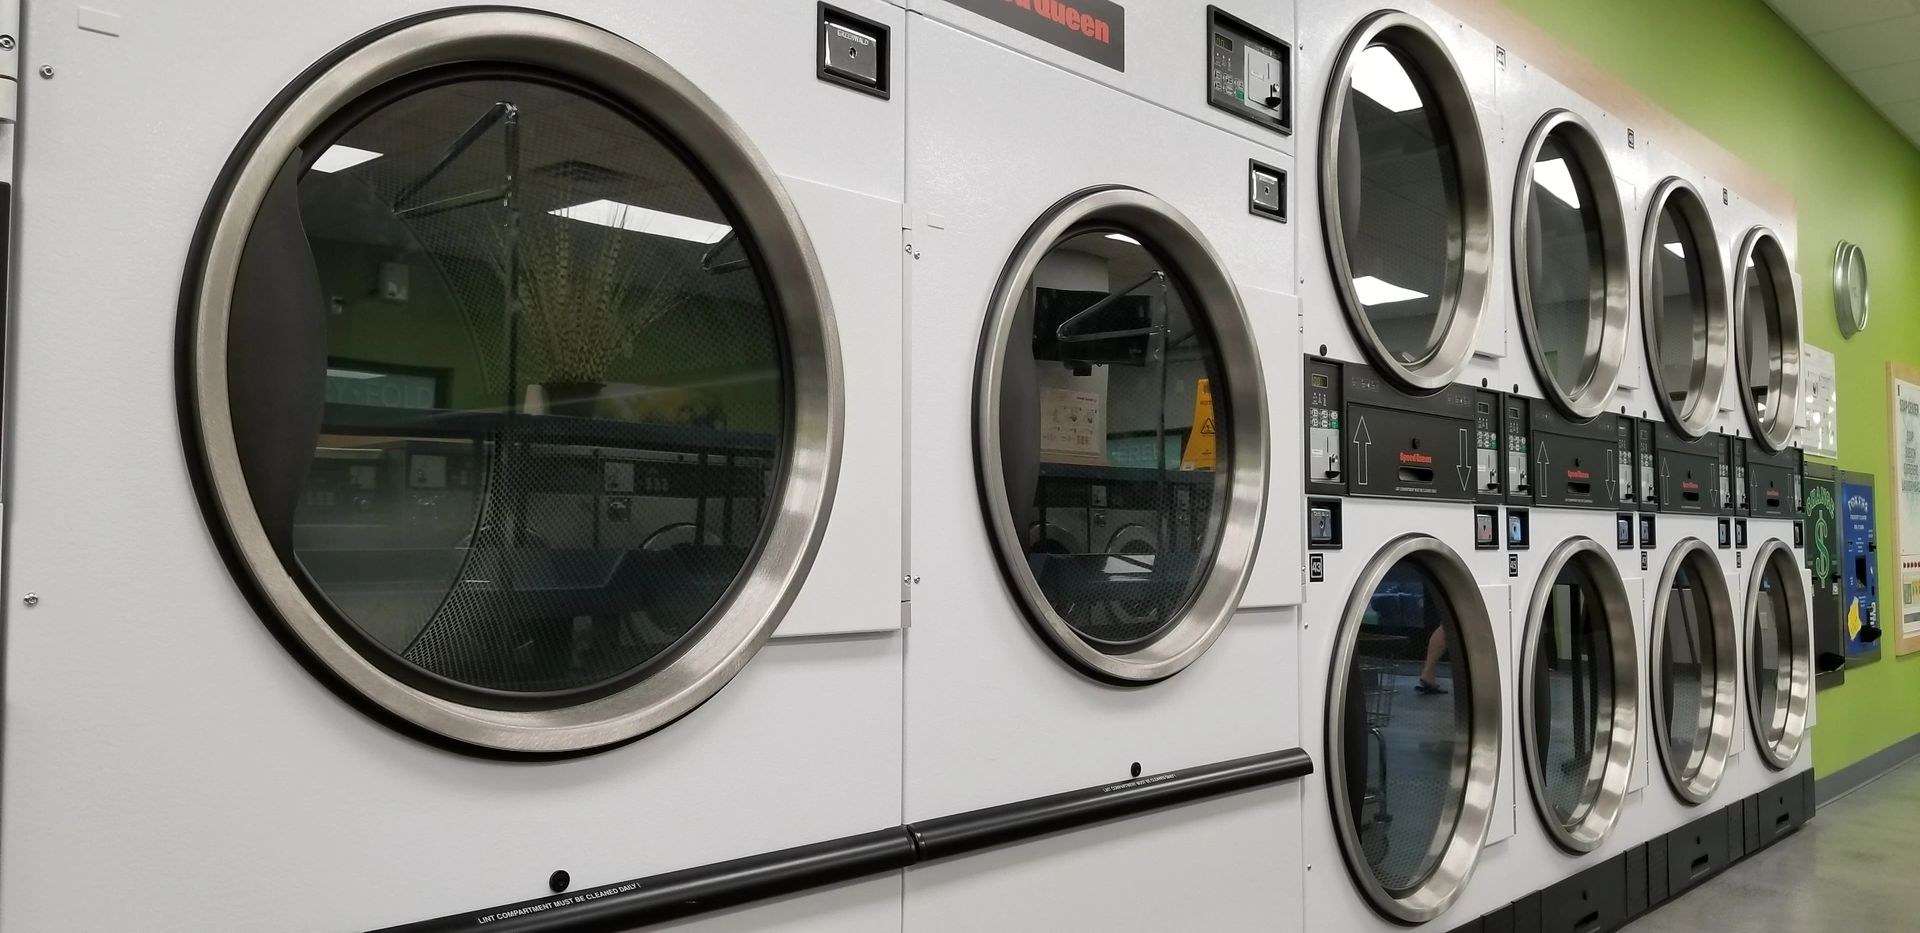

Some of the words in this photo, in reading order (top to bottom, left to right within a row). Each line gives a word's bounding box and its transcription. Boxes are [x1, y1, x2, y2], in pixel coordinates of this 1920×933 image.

[1312, 561, 1322, 573] 43
[478, 914, 496, 924] LINT
[496, 902, 553, 920] COMPARTMENT
[553, 898, 574, 908] MUST
[574, 895, 586, 903] BE
[585, 888, 619, 900] CLEANED
[618, 883, 637, 893] DAILY
